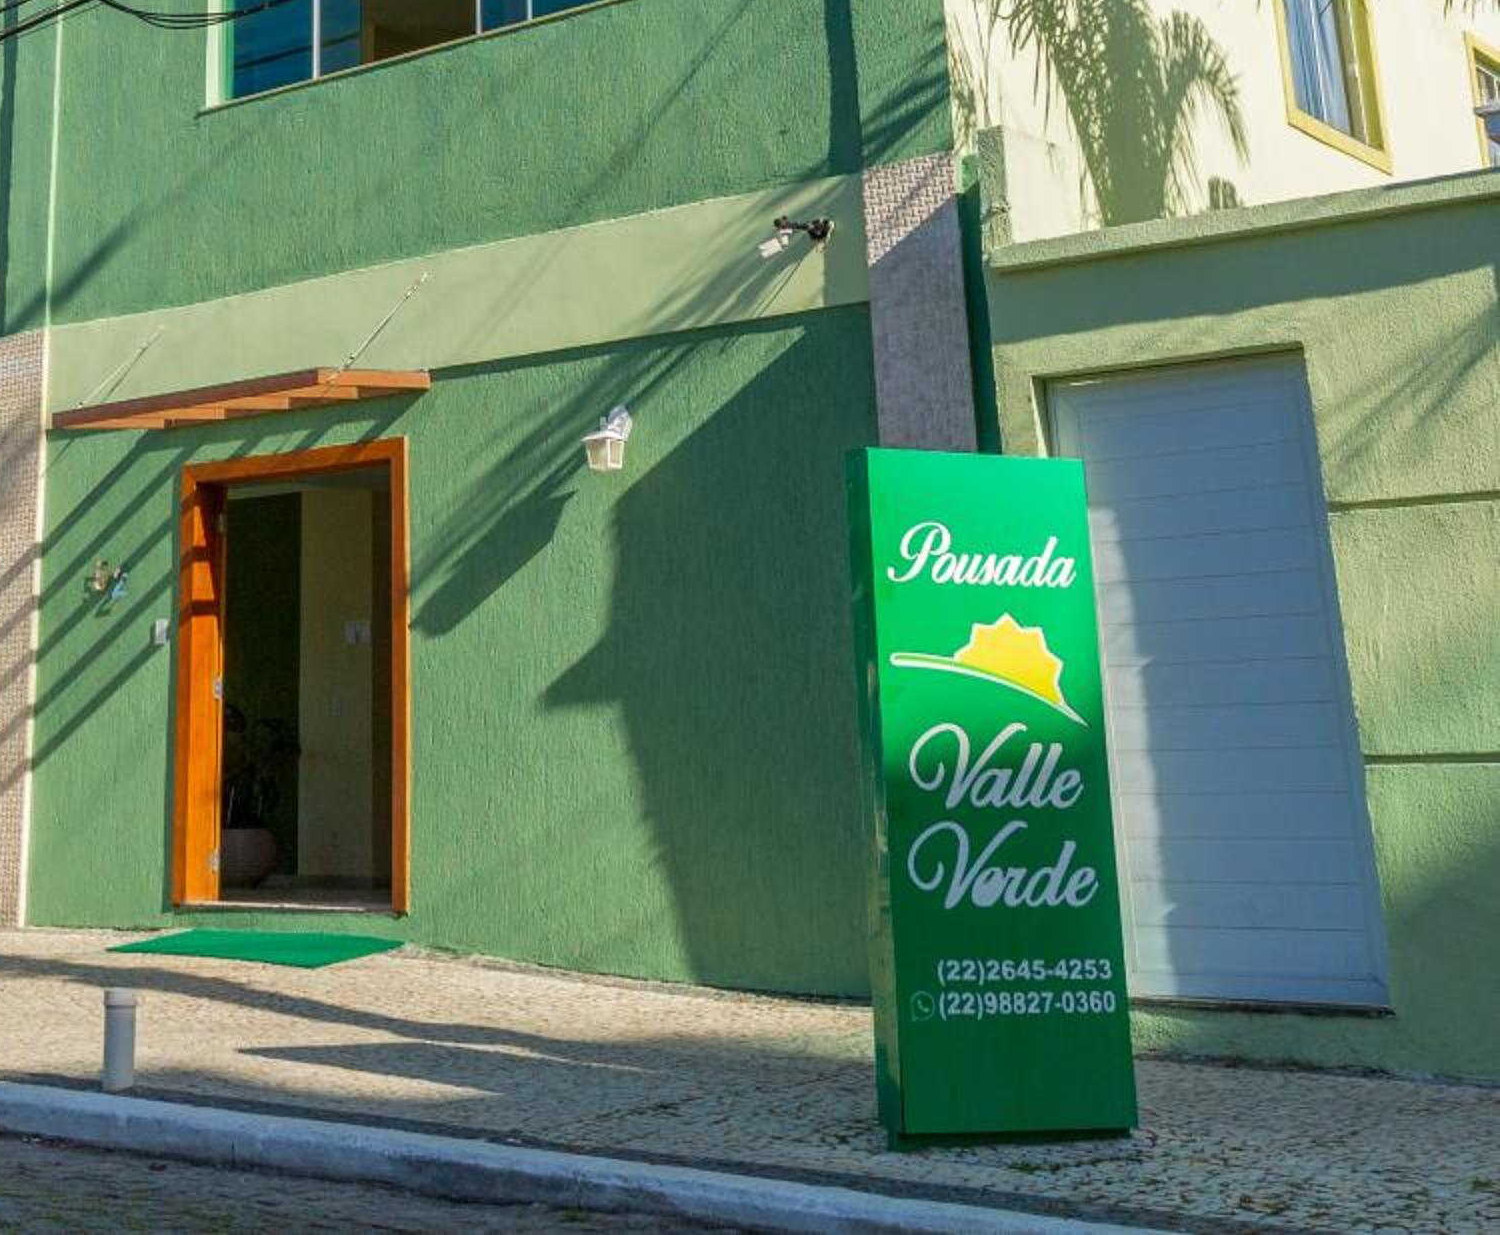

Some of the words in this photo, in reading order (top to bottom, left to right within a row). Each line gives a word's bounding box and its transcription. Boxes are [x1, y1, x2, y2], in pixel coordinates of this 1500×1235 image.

[887, 521, 1076, 588] Pousada
[909, 722, 1083, 810] Valle
[937, 959, 1113, 986] (22)2645-4253
[938, 990, 1116, 1021] (22)98827-0360
